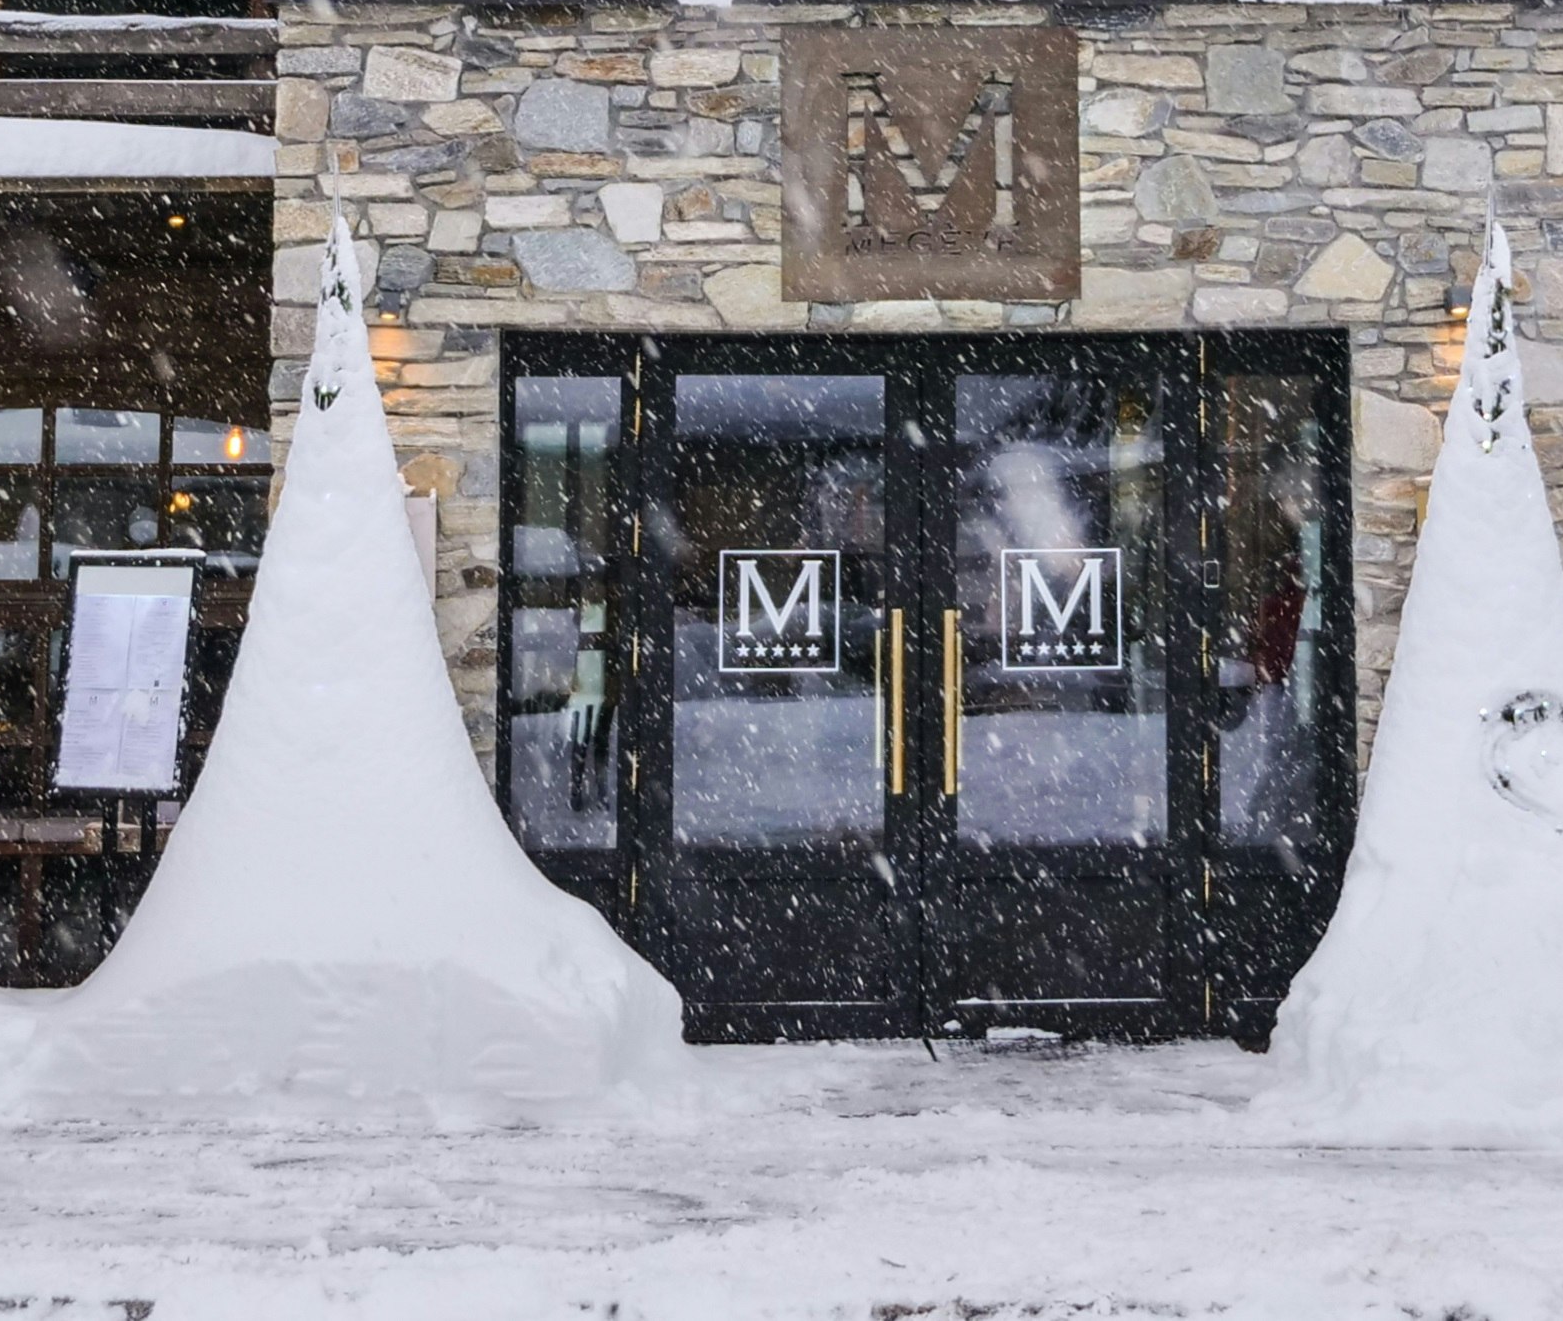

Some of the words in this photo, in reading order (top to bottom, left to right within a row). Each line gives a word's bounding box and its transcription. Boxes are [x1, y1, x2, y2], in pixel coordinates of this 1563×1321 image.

[841, 72, 1021, 227] M
[737, 559, 823, 636] M
[1018, 558, 1103, 635] M
